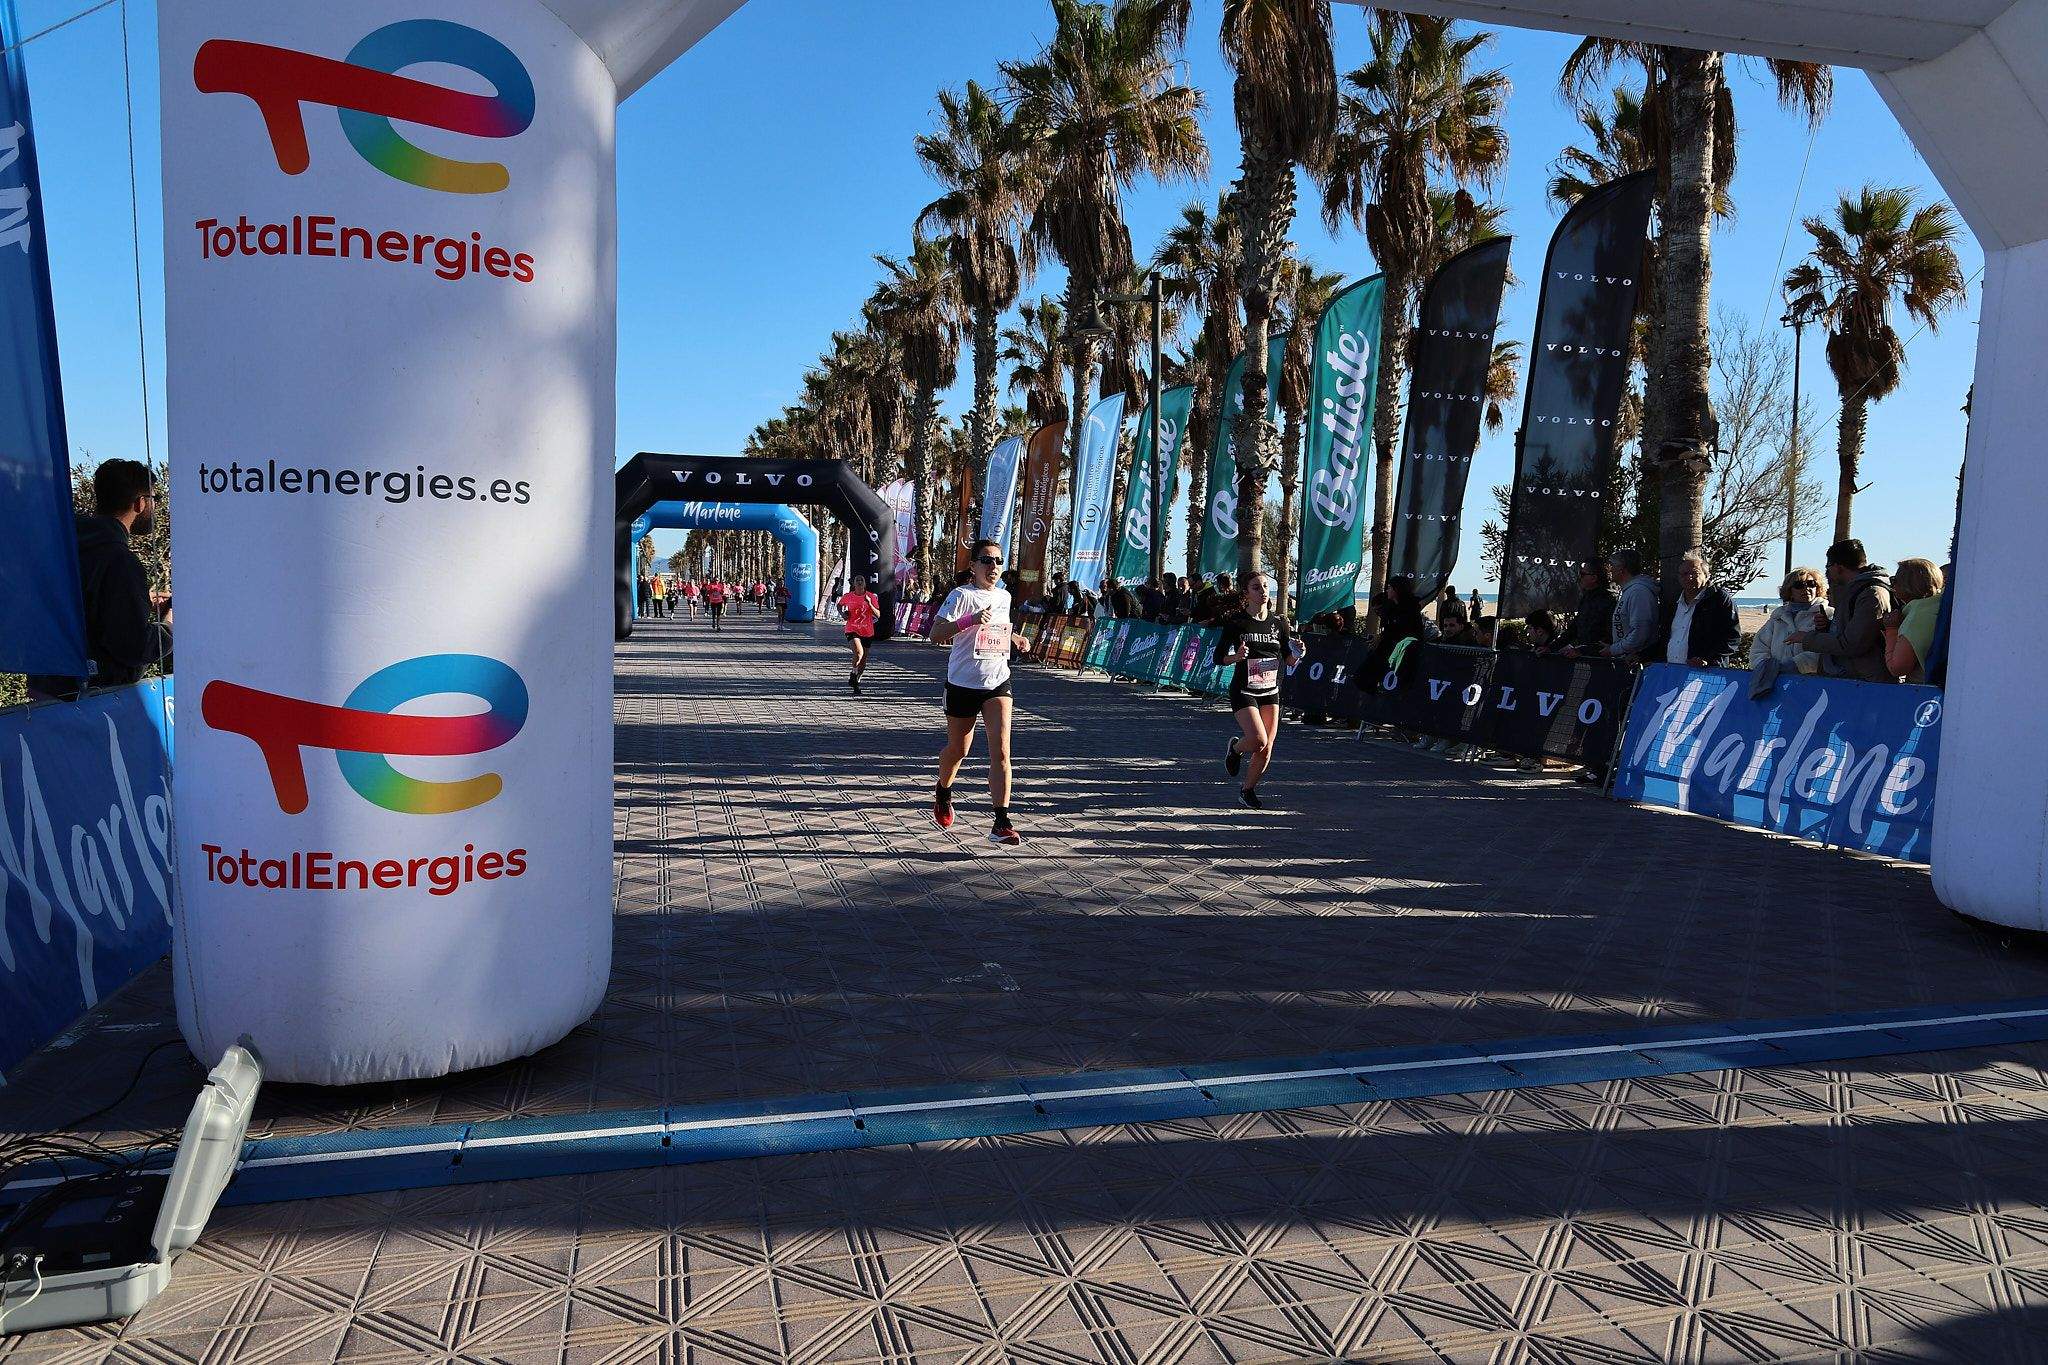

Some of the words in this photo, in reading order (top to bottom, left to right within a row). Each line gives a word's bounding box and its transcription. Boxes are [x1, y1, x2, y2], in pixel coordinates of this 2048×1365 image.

[195, 215, 535, 283] TotalEnergies
[1556, 271, 1632, 286] VOLVO
[1429, 329, 1489, 340] VOLVO
[1546, 343, 1621, 357] VOLVO
[1421, 391, 1480, 402] VOLVO
[1537, 414, 1611, 427] VOLVO
[1311, 329, 1370, 531] Batiste
[1413, 453, 1470, 463] VOLVO
[199, 459, 531, 505] totalenergies.es
[671, 470, 813, 487] VOLVO
[1526, 486, 1600, 498] VOLVO
[683, 501, 742, 526] Marlene
[1405, 512, 1457, 521] VOLVO
[1305, 561, 1358, 585] Batiste
[1428, 678, 1603, 724] VOLVO
[1634, 678, 1926, 834] Marlene
[201, 843, 528, 896] TotalEnergies
